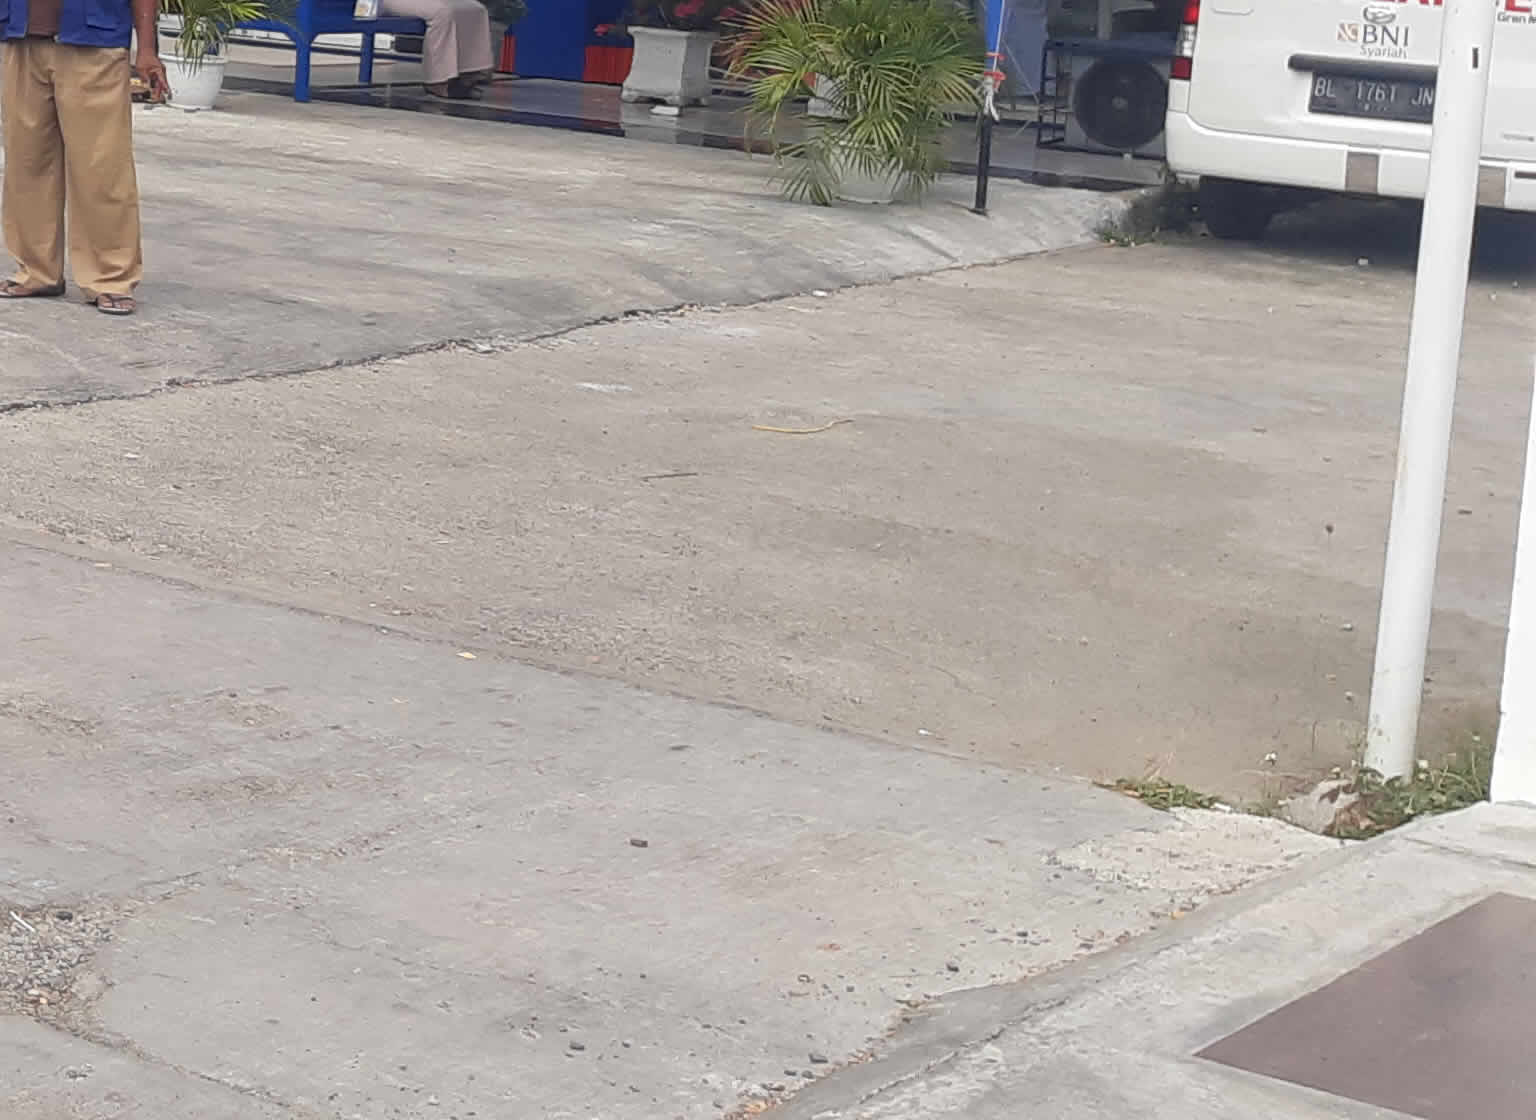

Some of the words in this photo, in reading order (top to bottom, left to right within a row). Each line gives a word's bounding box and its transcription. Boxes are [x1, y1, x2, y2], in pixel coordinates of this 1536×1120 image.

[1362, 24, 1410, 47] BNI
[1359, 45, 1408, 60] Syariah
[1314, 77, 1337, 98] BL
